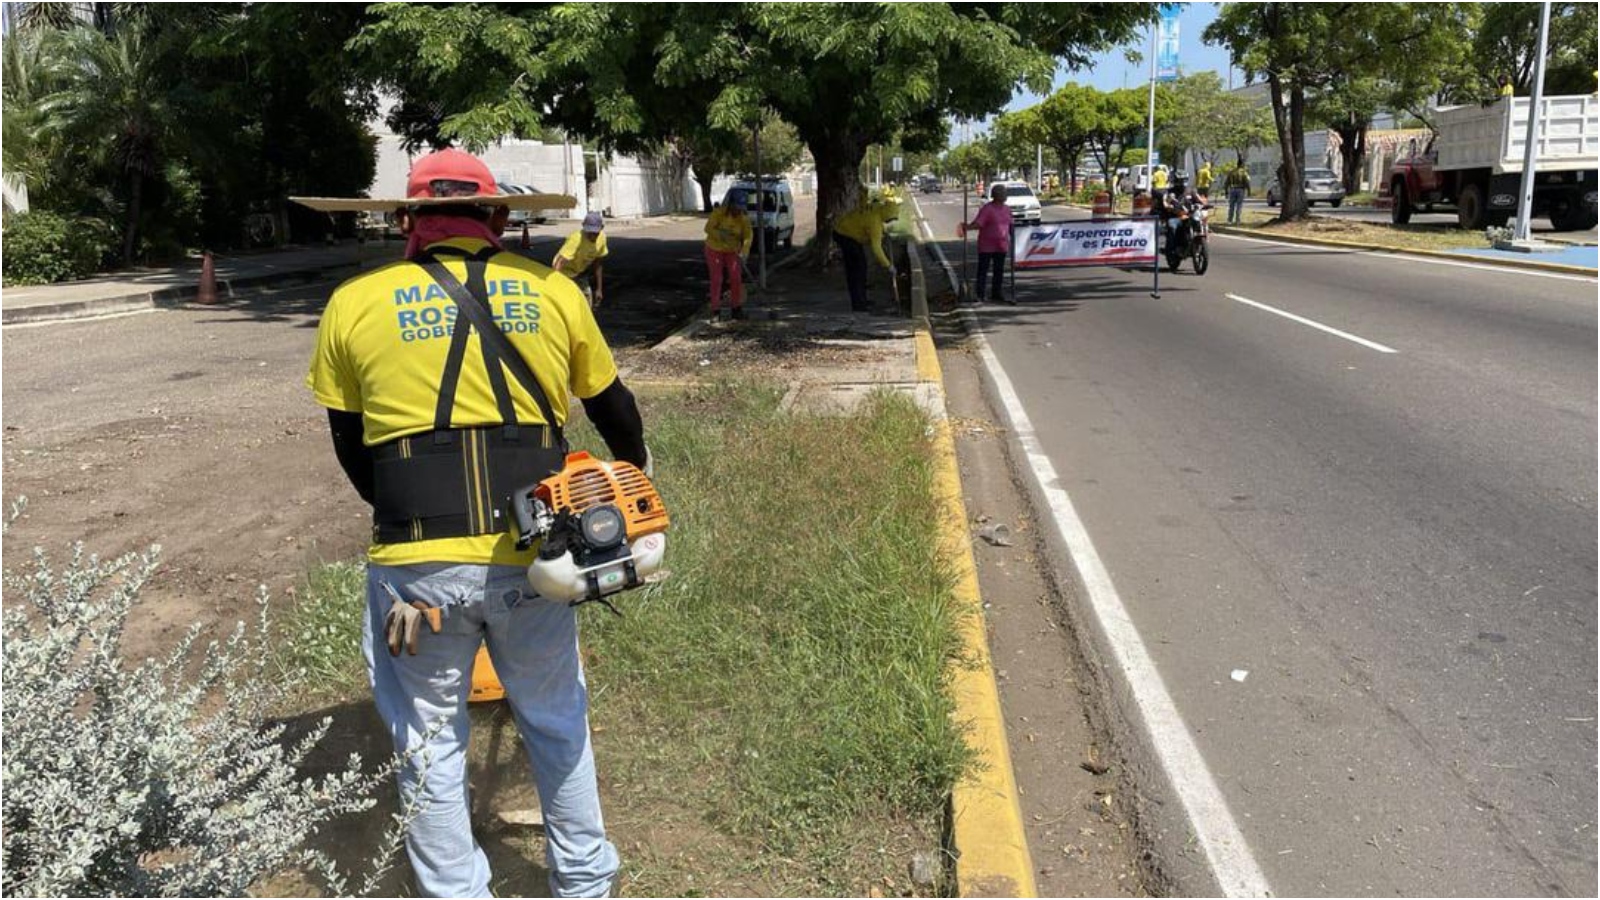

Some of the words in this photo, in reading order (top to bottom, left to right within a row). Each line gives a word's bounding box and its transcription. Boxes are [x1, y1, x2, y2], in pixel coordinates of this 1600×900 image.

[1061, 228, 1133, 240] Esperanza
[1082, 240, 1098, 249] es
[1101, 238, 1148, 249] Futuro
[394, 280, 539, 305] MAUEL
[397, 302, 541, 328] ROSLES
